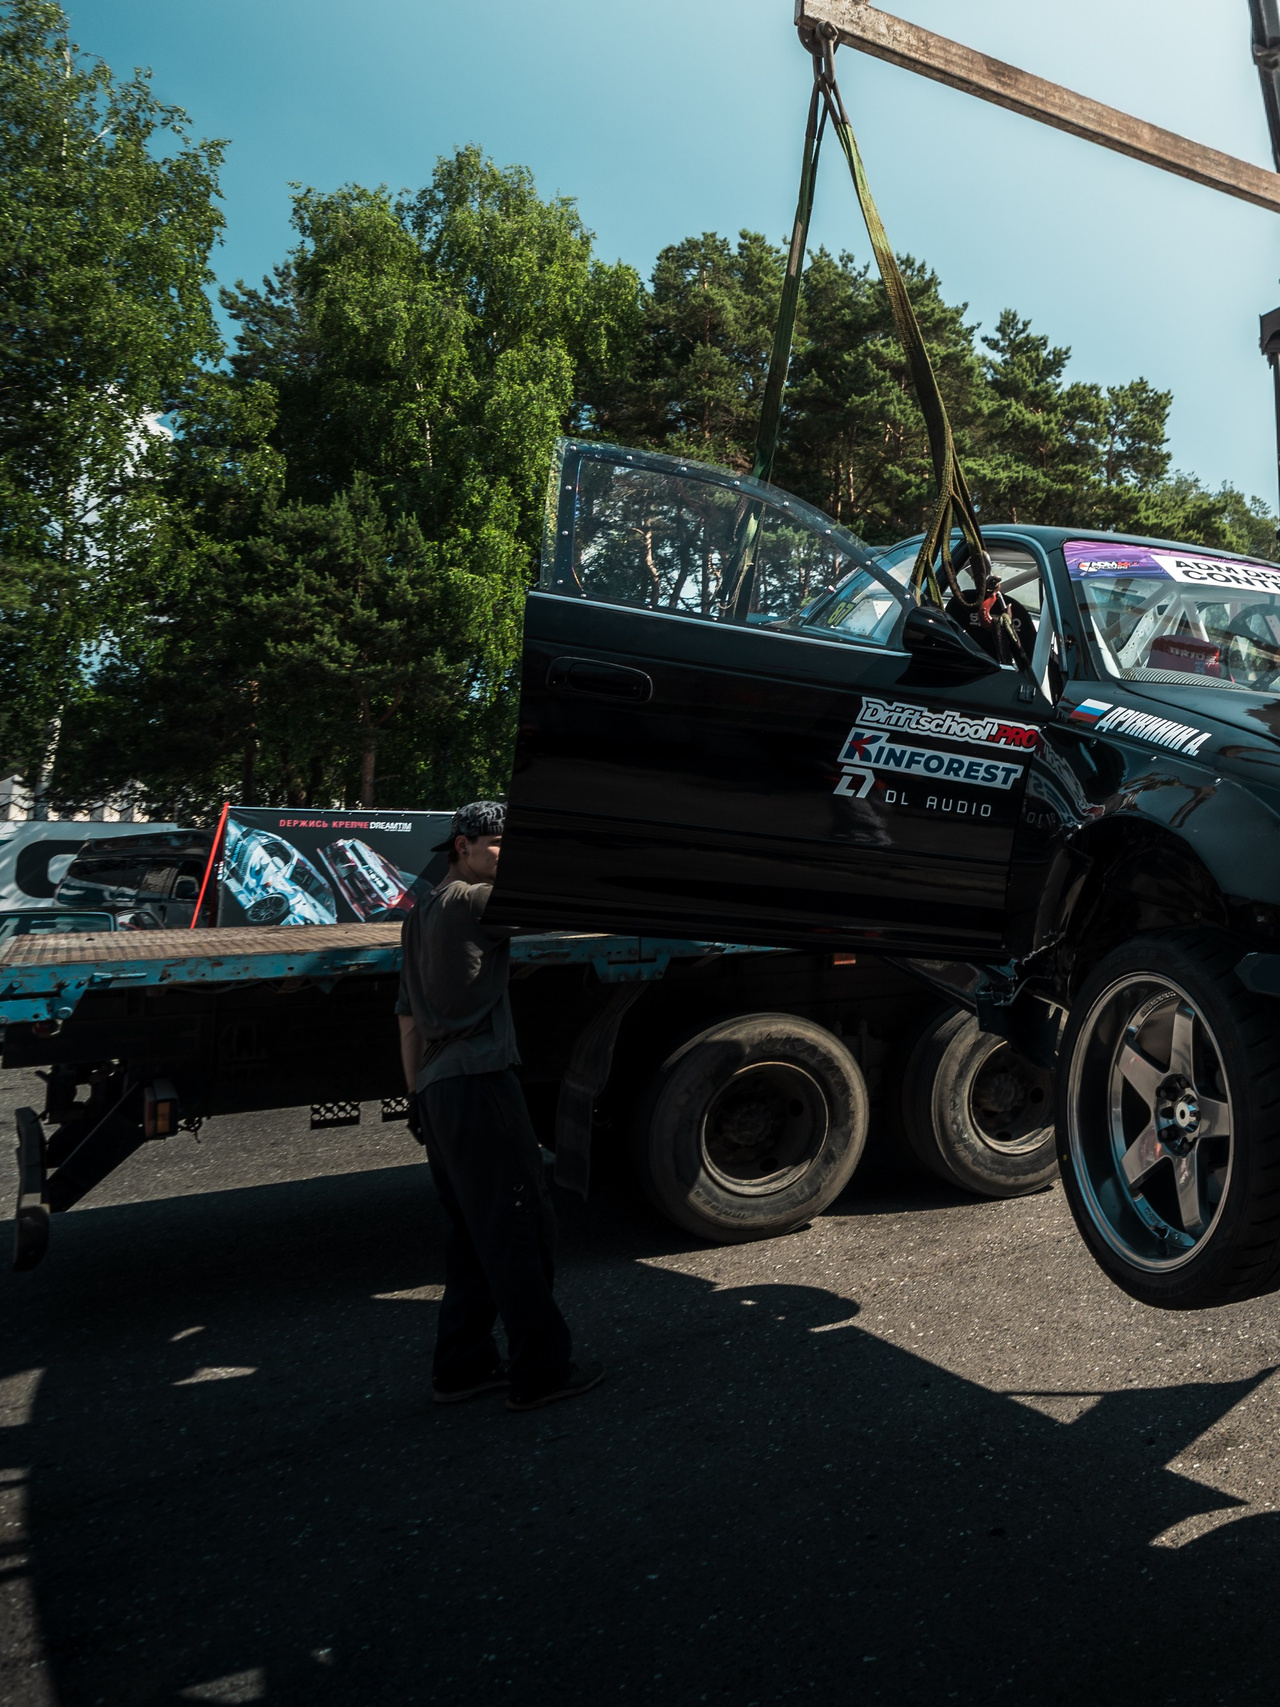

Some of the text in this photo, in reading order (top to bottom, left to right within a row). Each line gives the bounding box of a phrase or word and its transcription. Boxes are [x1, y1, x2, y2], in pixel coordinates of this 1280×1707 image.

[1175, 560, 1238, 575] ADM
[827, 601, 855, 627] 87
[1094, 706, 1200, 750] ДРУЖИНИН
[842, 730, 1019, 786] KINFOREST
[885, 789, 992, 818] DL AUDIO
[332, 820, 370, 829] КРЕПЧЕ
